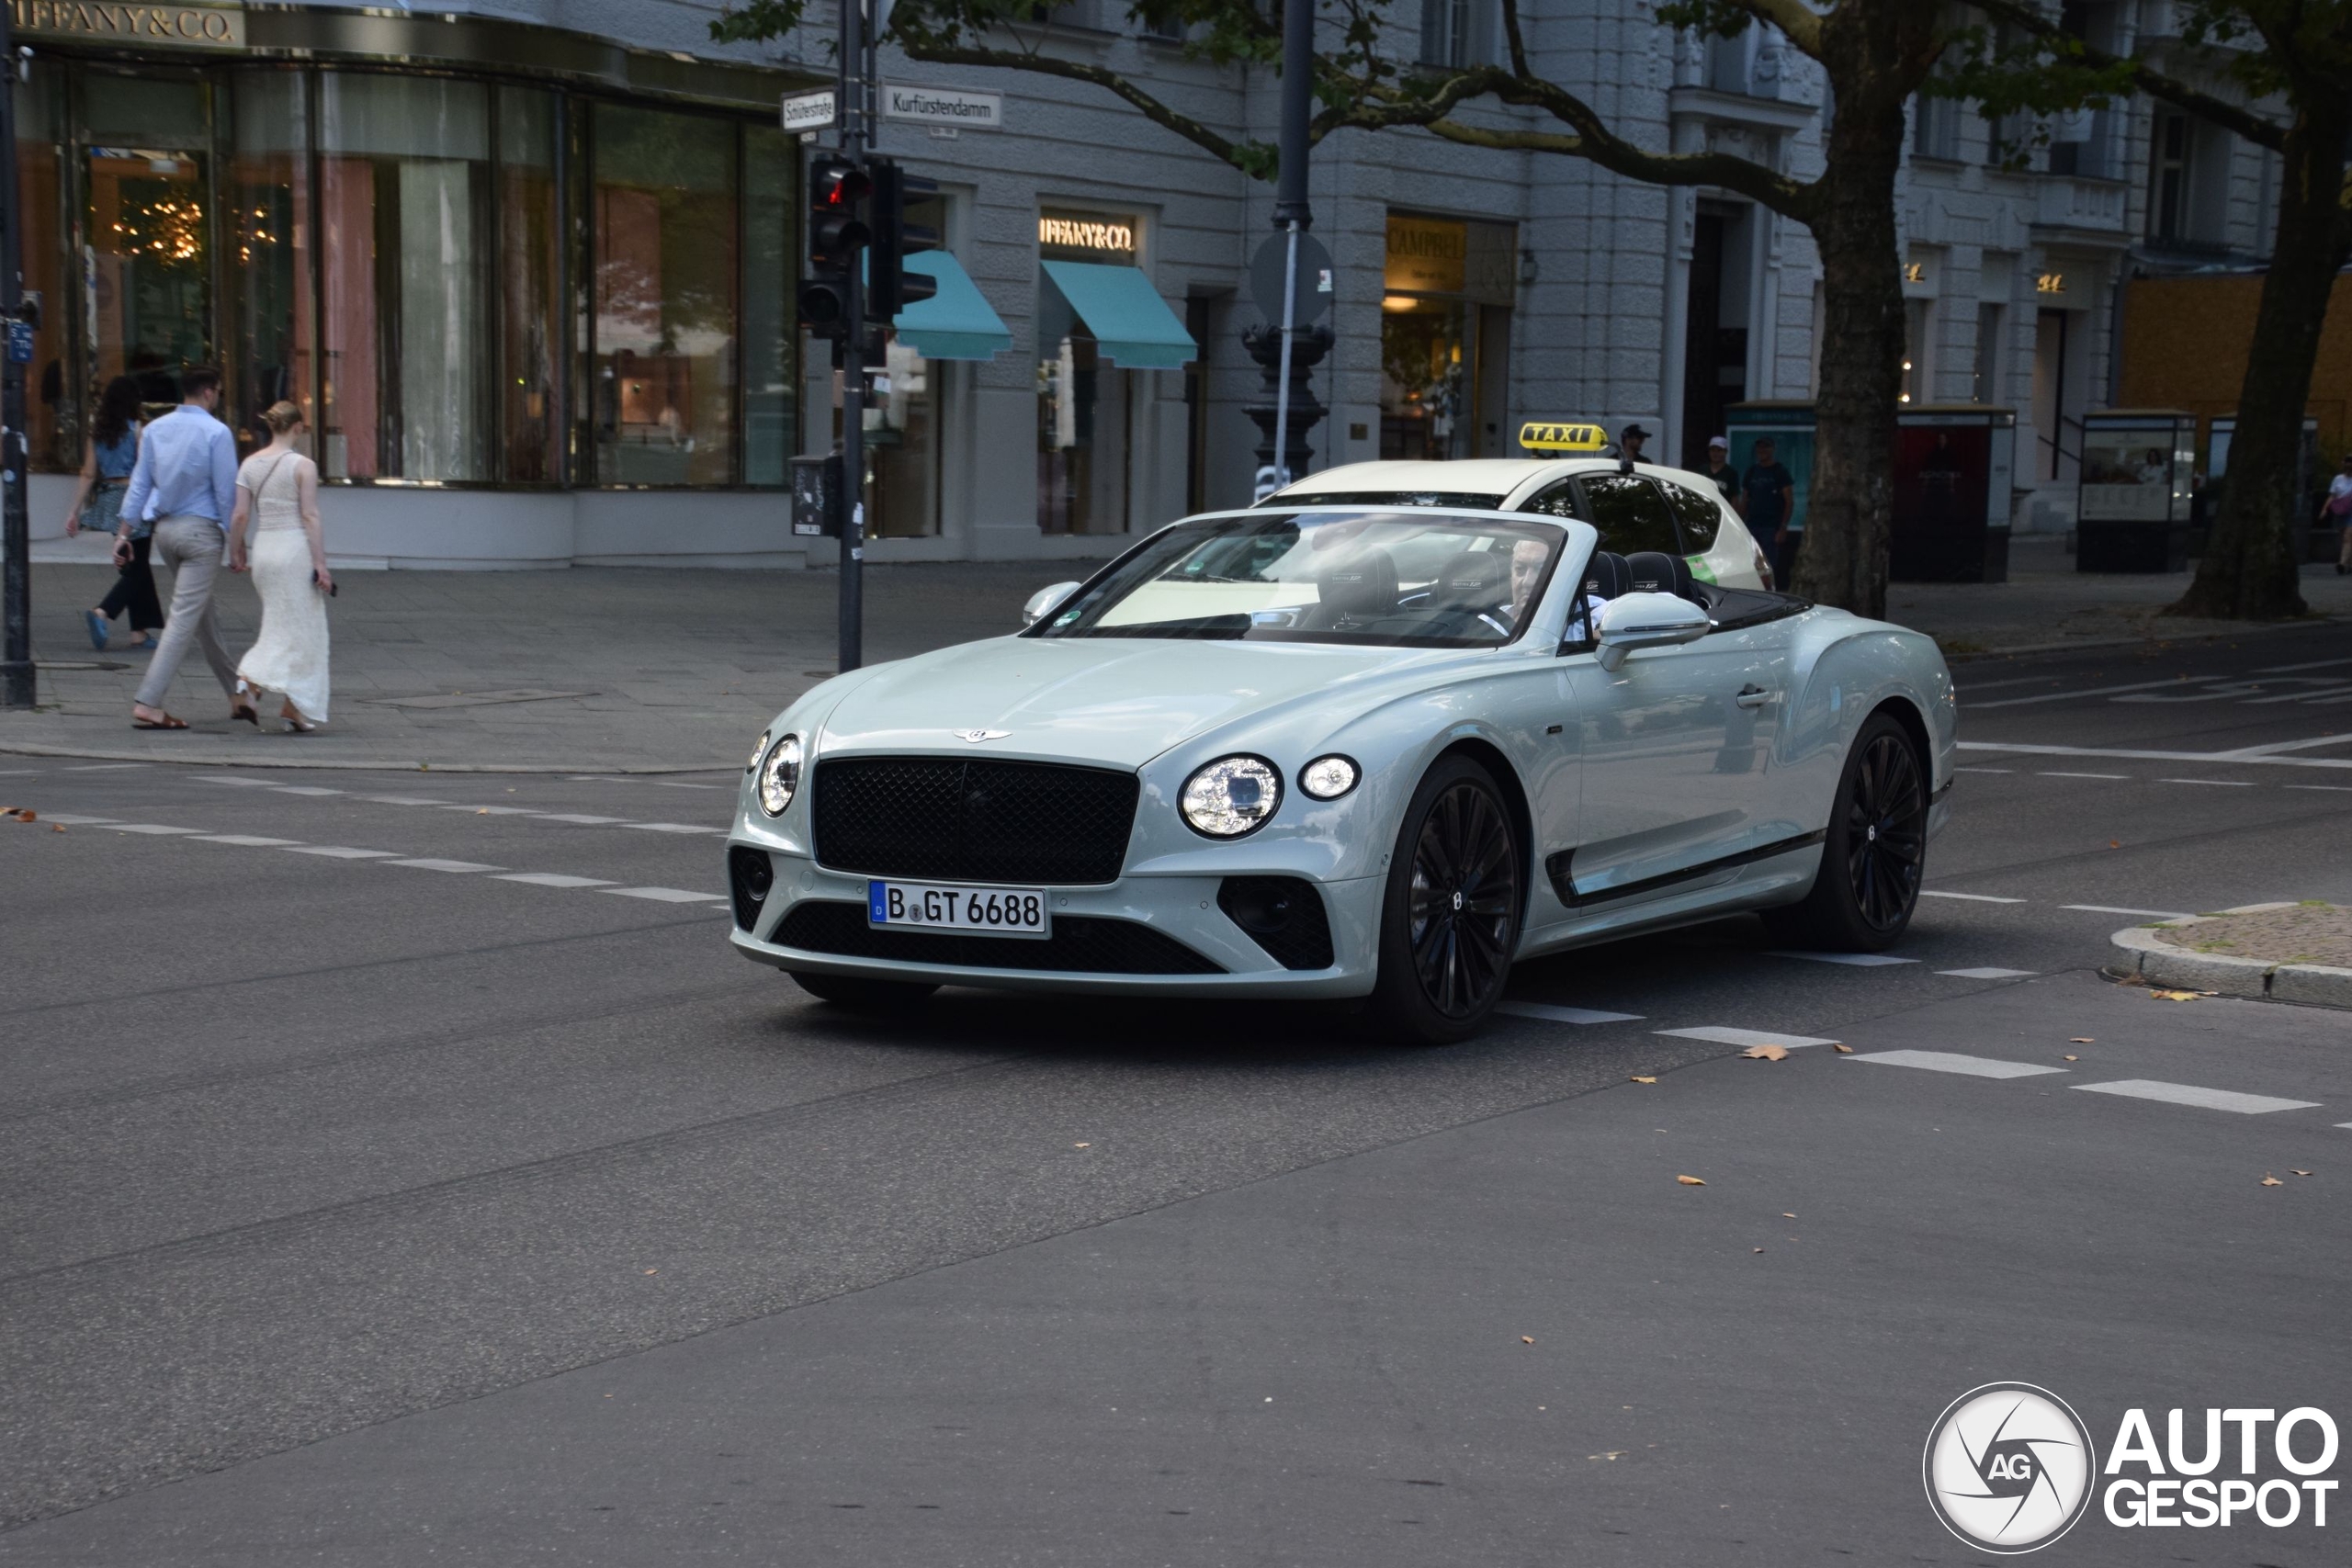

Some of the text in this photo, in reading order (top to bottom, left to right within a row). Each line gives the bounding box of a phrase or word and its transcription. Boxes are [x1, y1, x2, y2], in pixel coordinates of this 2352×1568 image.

[7, 0, 234, 41] IFFANY&CO.
[893, 92, 991, 118] Kurfürstendamm
[1532, 427, 1584, 443] TAXI
[876, 906, 882, 915] D
[888, 887, 1040, 927] B GT 6688
